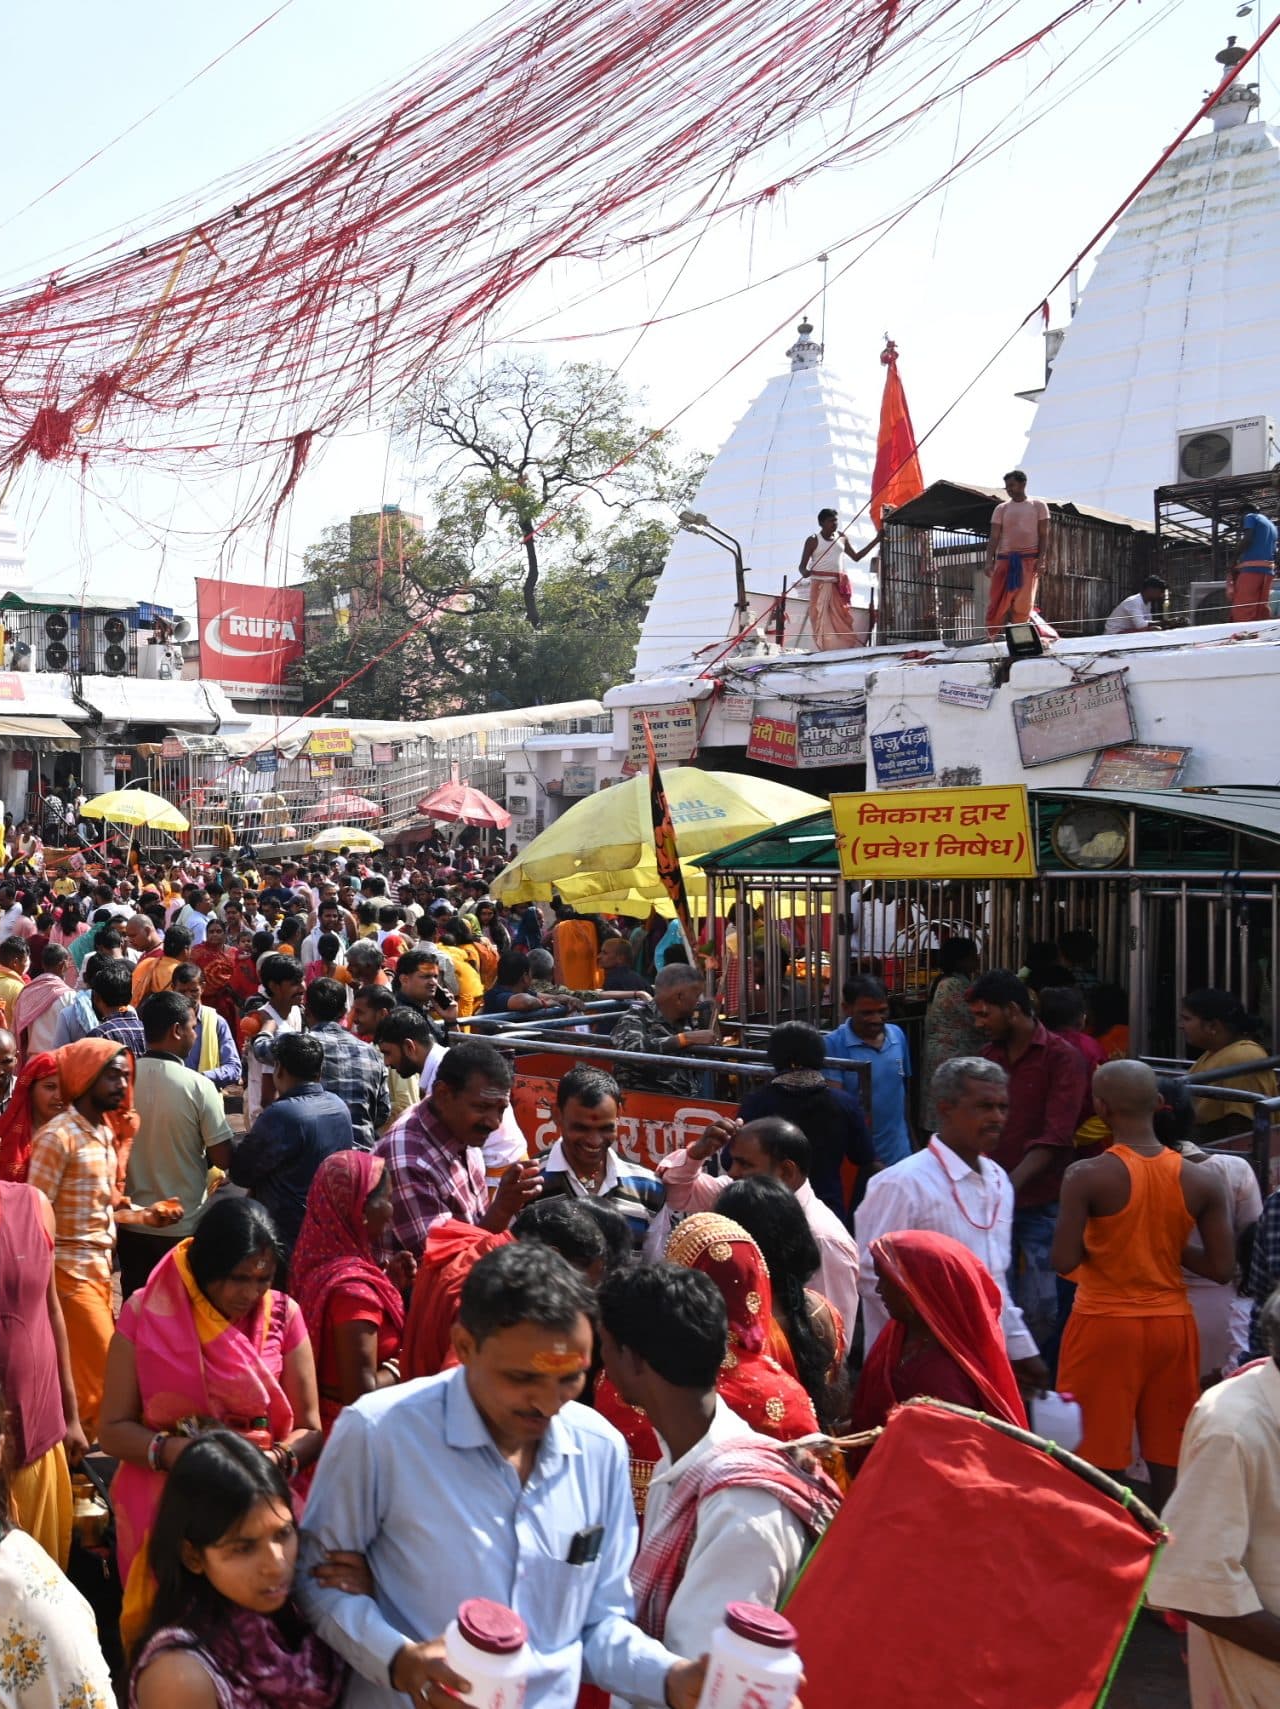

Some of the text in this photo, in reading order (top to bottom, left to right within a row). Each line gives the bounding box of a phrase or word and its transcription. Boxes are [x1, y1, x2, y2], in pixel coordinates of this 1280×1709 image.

[229, 615, 296, 641] RUPA
[900, 731, 929, 745] पंडा
[857, 802, 1011, 826] निकास द्वार
[851, 831, 1026, 866] (प्रवेश निषेध)
